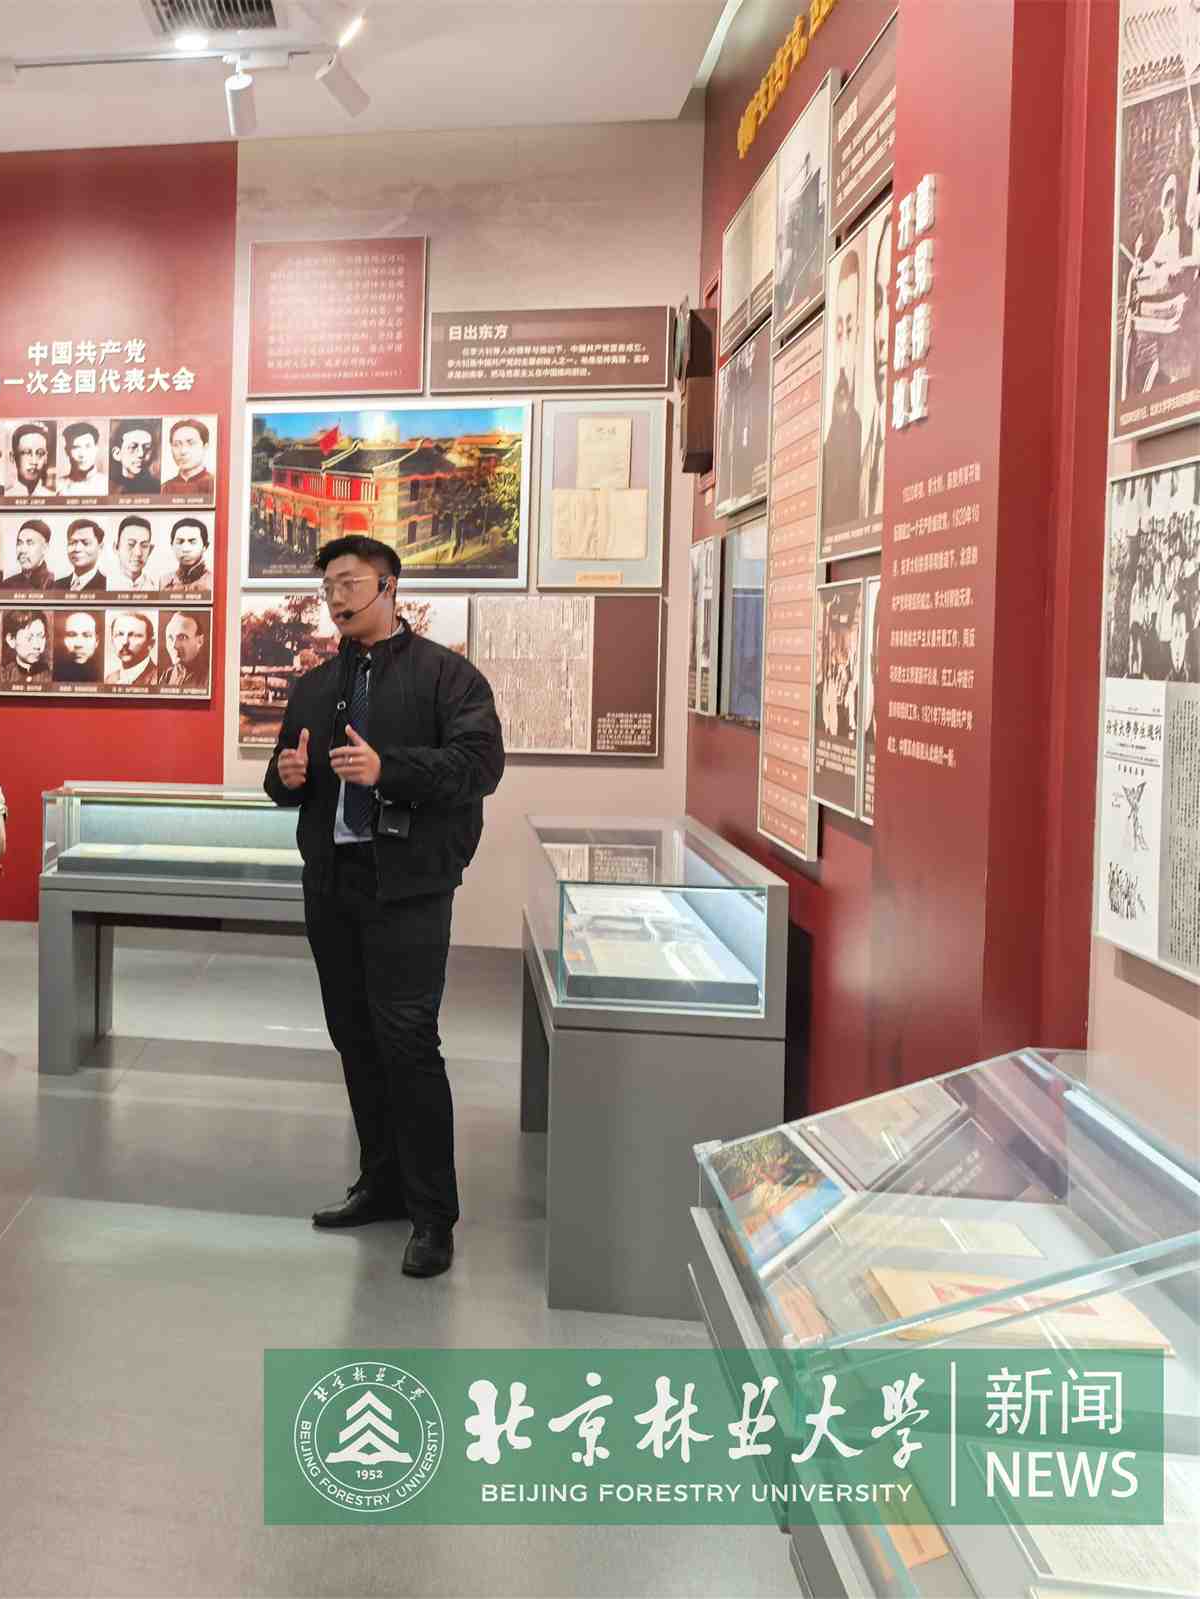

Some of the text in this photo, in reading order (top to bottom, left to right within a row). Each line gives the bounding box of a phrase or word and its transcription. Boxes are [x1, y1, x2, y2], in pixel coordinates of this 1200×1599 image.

[448, 324, 509, 341] 日出东方
[27, 338, 147, 366] 中国共产党
